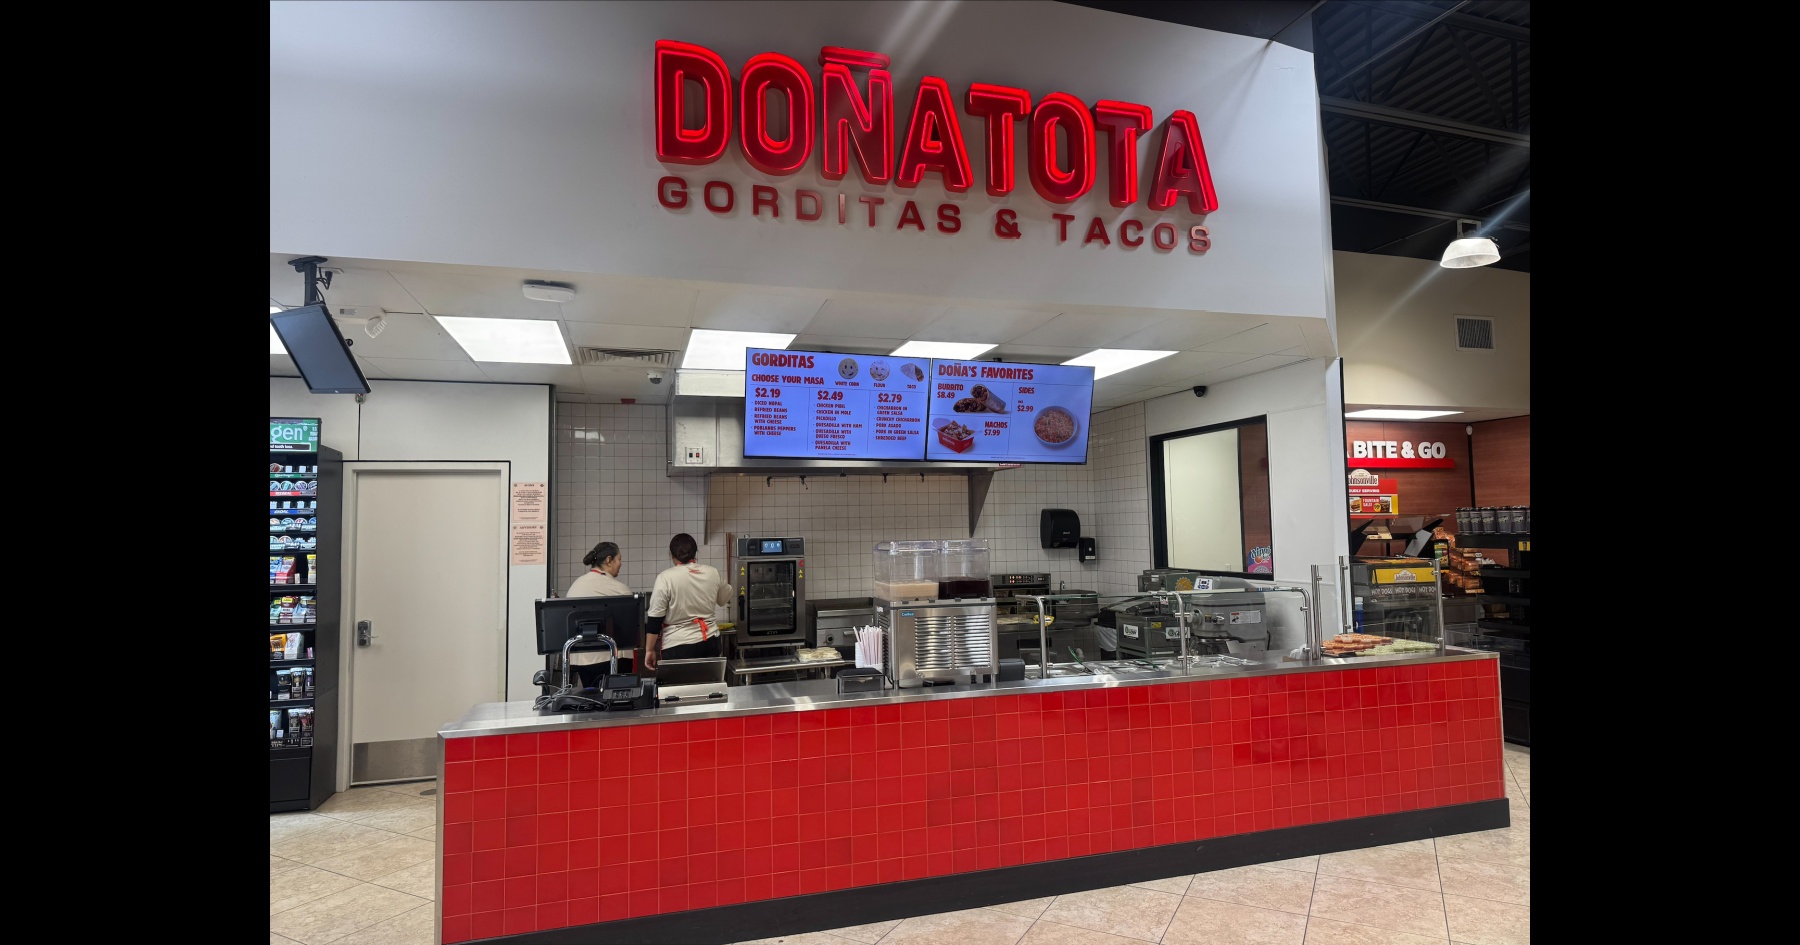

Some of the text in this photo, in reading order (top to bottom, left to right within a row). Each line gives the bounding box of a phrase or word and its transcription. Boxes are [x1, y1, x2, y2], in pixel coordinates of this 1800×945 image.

[656, 176, 1212, 254] GORDITAS & TACOS
[752, 352, 814, 368] GORDITAS
[938, 362, 1034, 380] DOÑA'S FAVORITES
[752, 374, 824, 385] CHOOSE YOUR MASA
[755, 387, 780, 398] $2.19
[938, 383, 964, 391] BURRITO
[817, 390, 843, 401] $2.49
[878, 392, 902, 403] $2.79
[1354, 441, 1398, 458] BITE
[1401, 441, 1415, 459] &
[1418, 441, 1446, 459] GO
